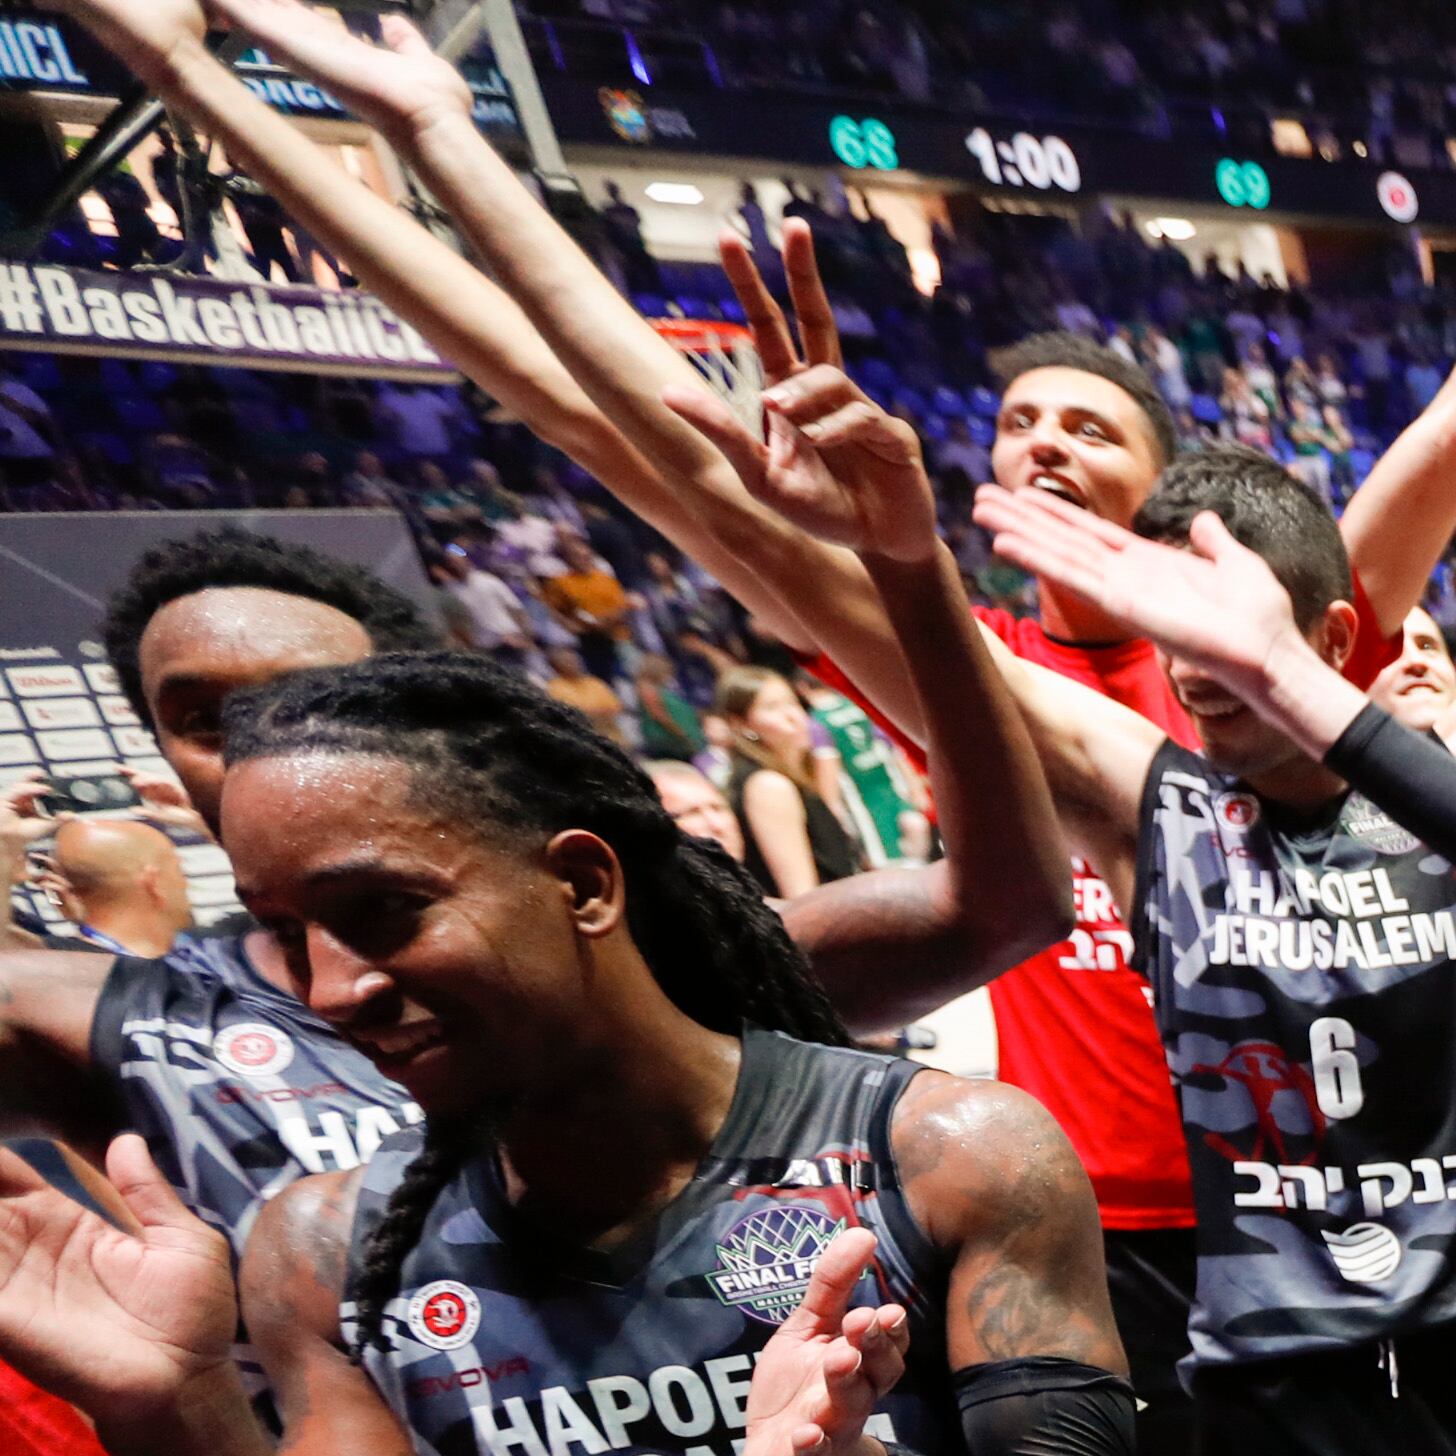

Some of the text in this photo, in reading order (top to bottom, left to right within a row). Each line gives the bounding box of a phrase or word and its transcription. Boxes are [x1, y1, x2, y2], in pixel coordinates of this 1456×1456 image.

[829, 114, 898, 171] 68
[965, 126, 1081, 192] 1:00
[1214, 156, 1271, 210] 69
[1236, 867, 1409, 917] HAPOEL
[1308, 1016, 1364, 1120] 6
[1233, 1159, 1345, 1211] יהב
[715, 1261, 790, 1293] FINAL
